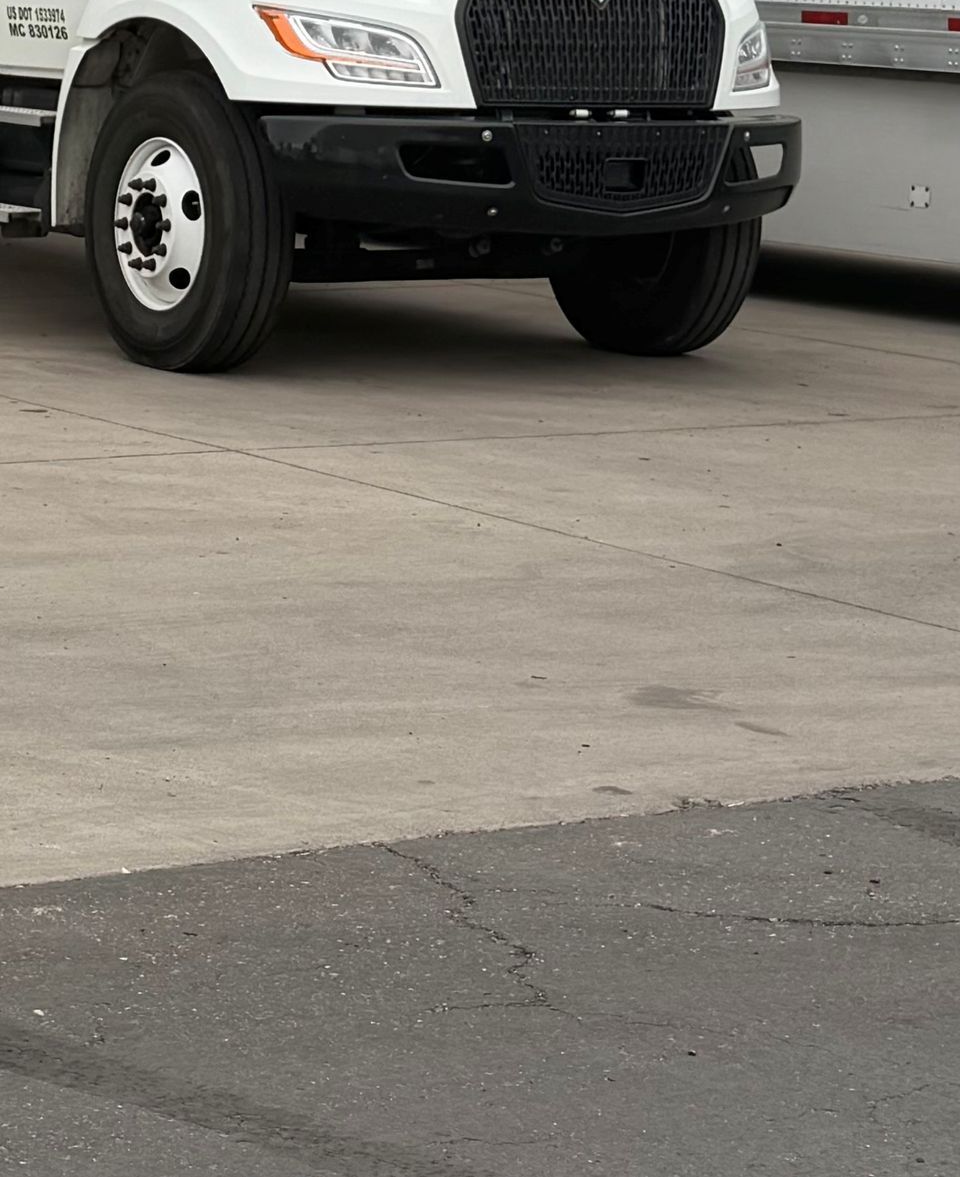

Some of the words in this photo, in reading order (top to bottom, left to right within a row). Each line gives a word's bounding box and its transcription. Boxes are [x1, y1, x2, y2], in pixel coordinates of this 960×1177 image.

[6, 6, 17, 20] US
[18, 7, 32, 21] DOT
[8, 23, 26, 37] MC
[28, 24, 68, 40] 830126
